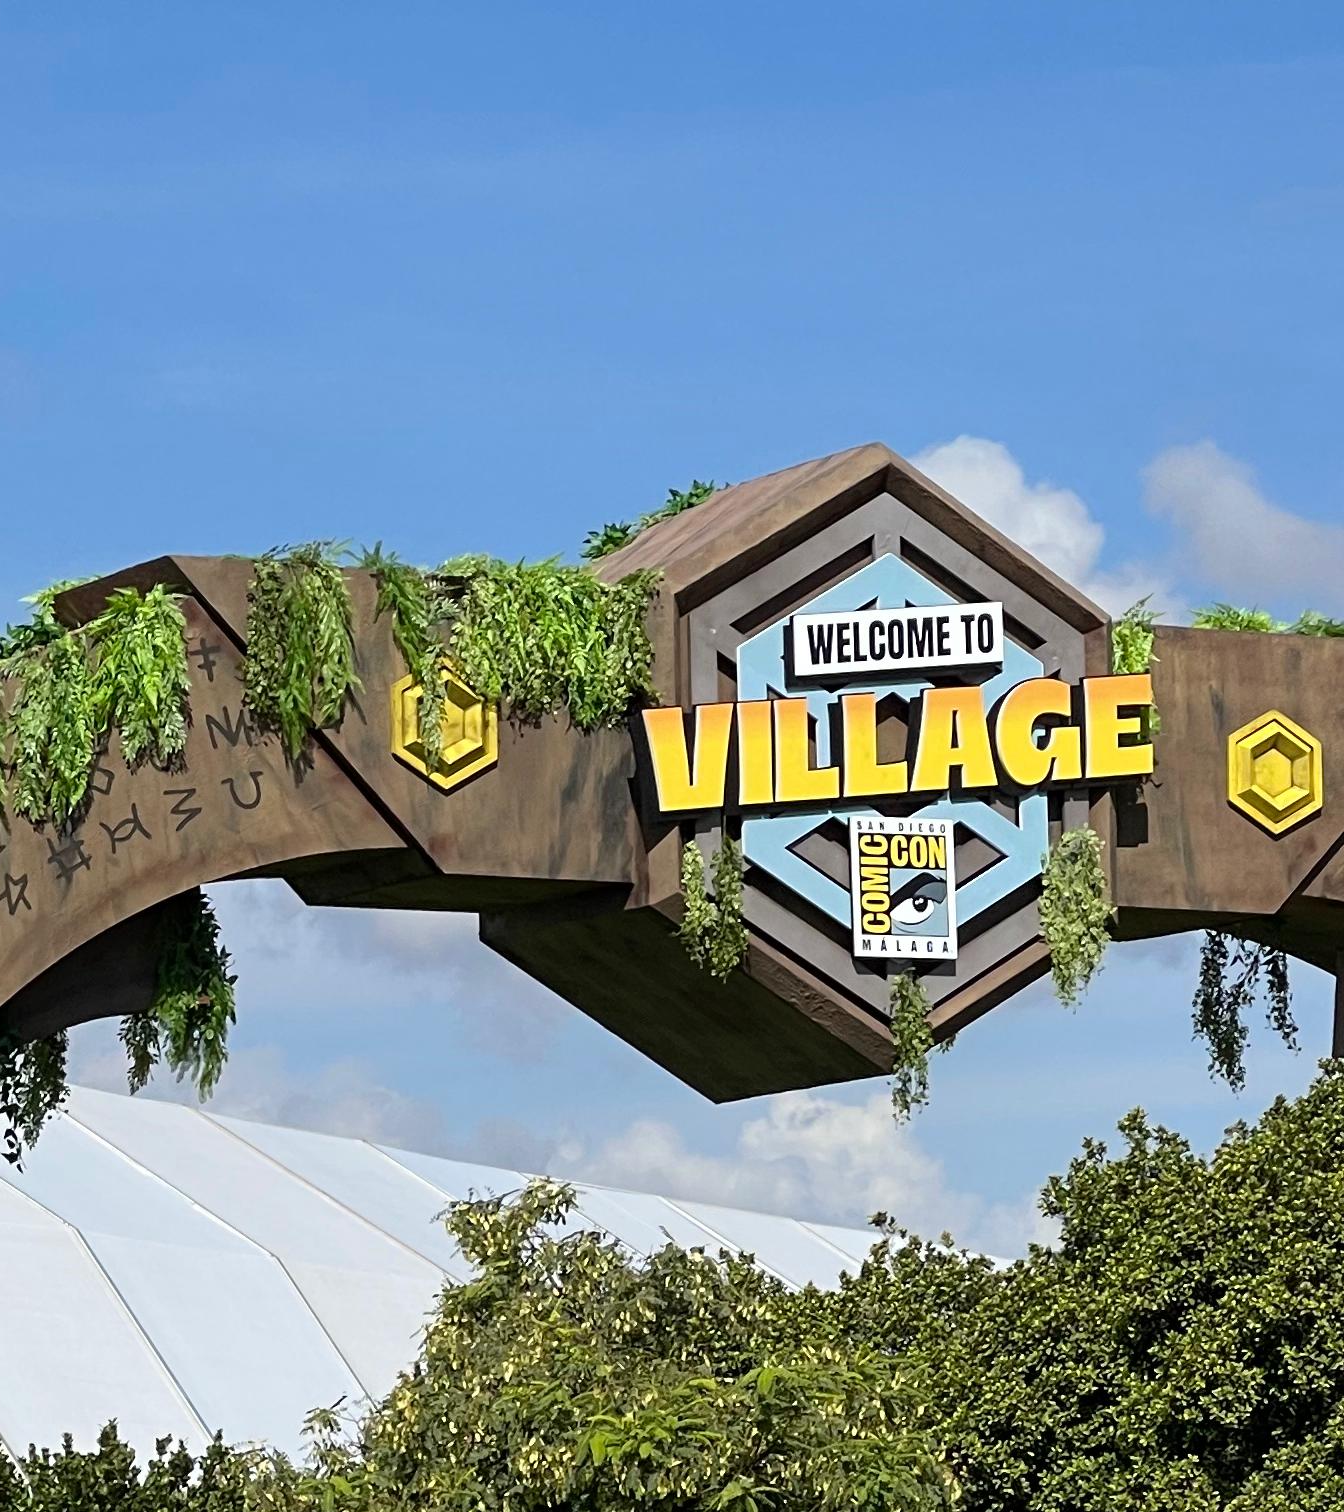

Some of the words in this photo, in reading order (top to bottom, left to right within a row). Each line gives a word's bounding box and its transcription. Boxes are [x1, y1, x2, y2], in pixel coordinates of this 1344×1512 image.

[807, 615, 951, 665] WELCOME
[960, 613, 994, 654] TO
[641, 673, 1154, 812] VILLAGE
[856, 820, 885, 831] SAN
[898, 822, 946, 834] DIEGO
[890, 834, 946, 869] CON
[859, 834, 891, 934] COMIC
[862, 937, 950, 953] MÁLAGA
